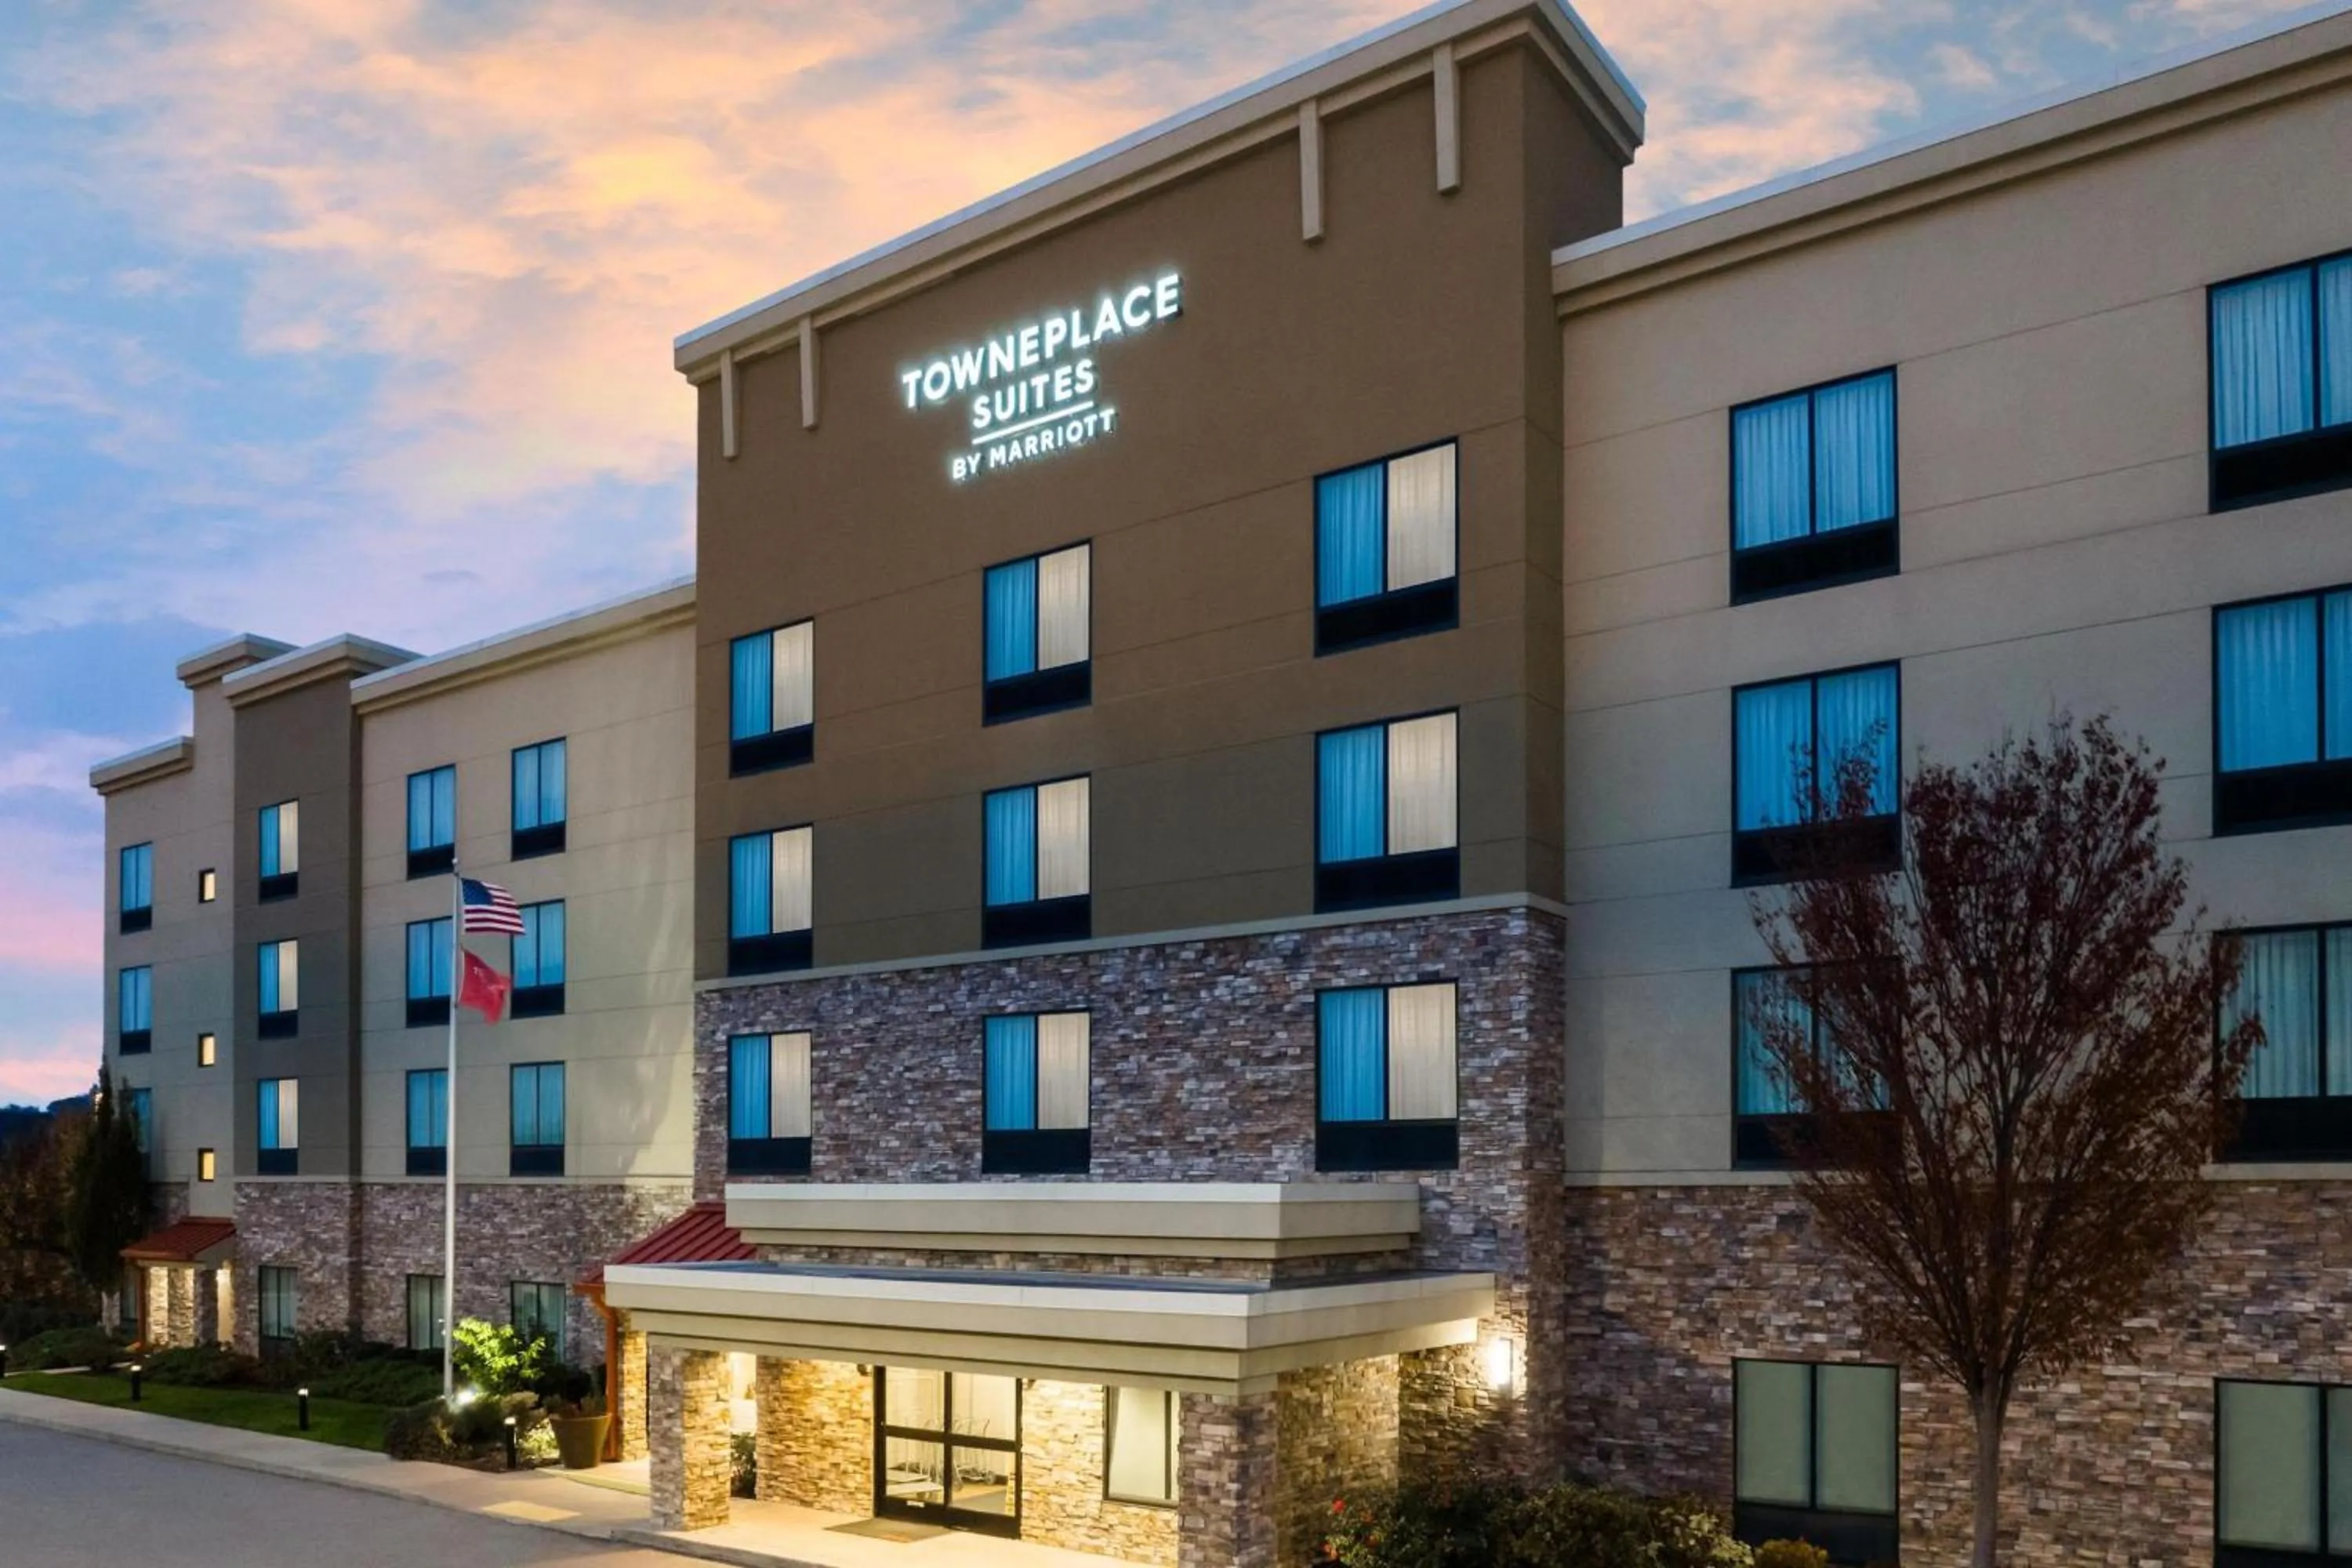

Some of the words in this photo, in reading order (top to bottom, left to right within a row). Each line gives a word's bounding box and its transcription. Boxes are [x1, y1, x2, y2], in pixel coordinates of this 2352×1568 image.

[902, 273, 1180, 408] TOWNEPLACE
[972, 359, 1094, 429] SUITES
[952, 452, 981, 479] BY
[989, 408, 1116, 468] MARRIOTT
